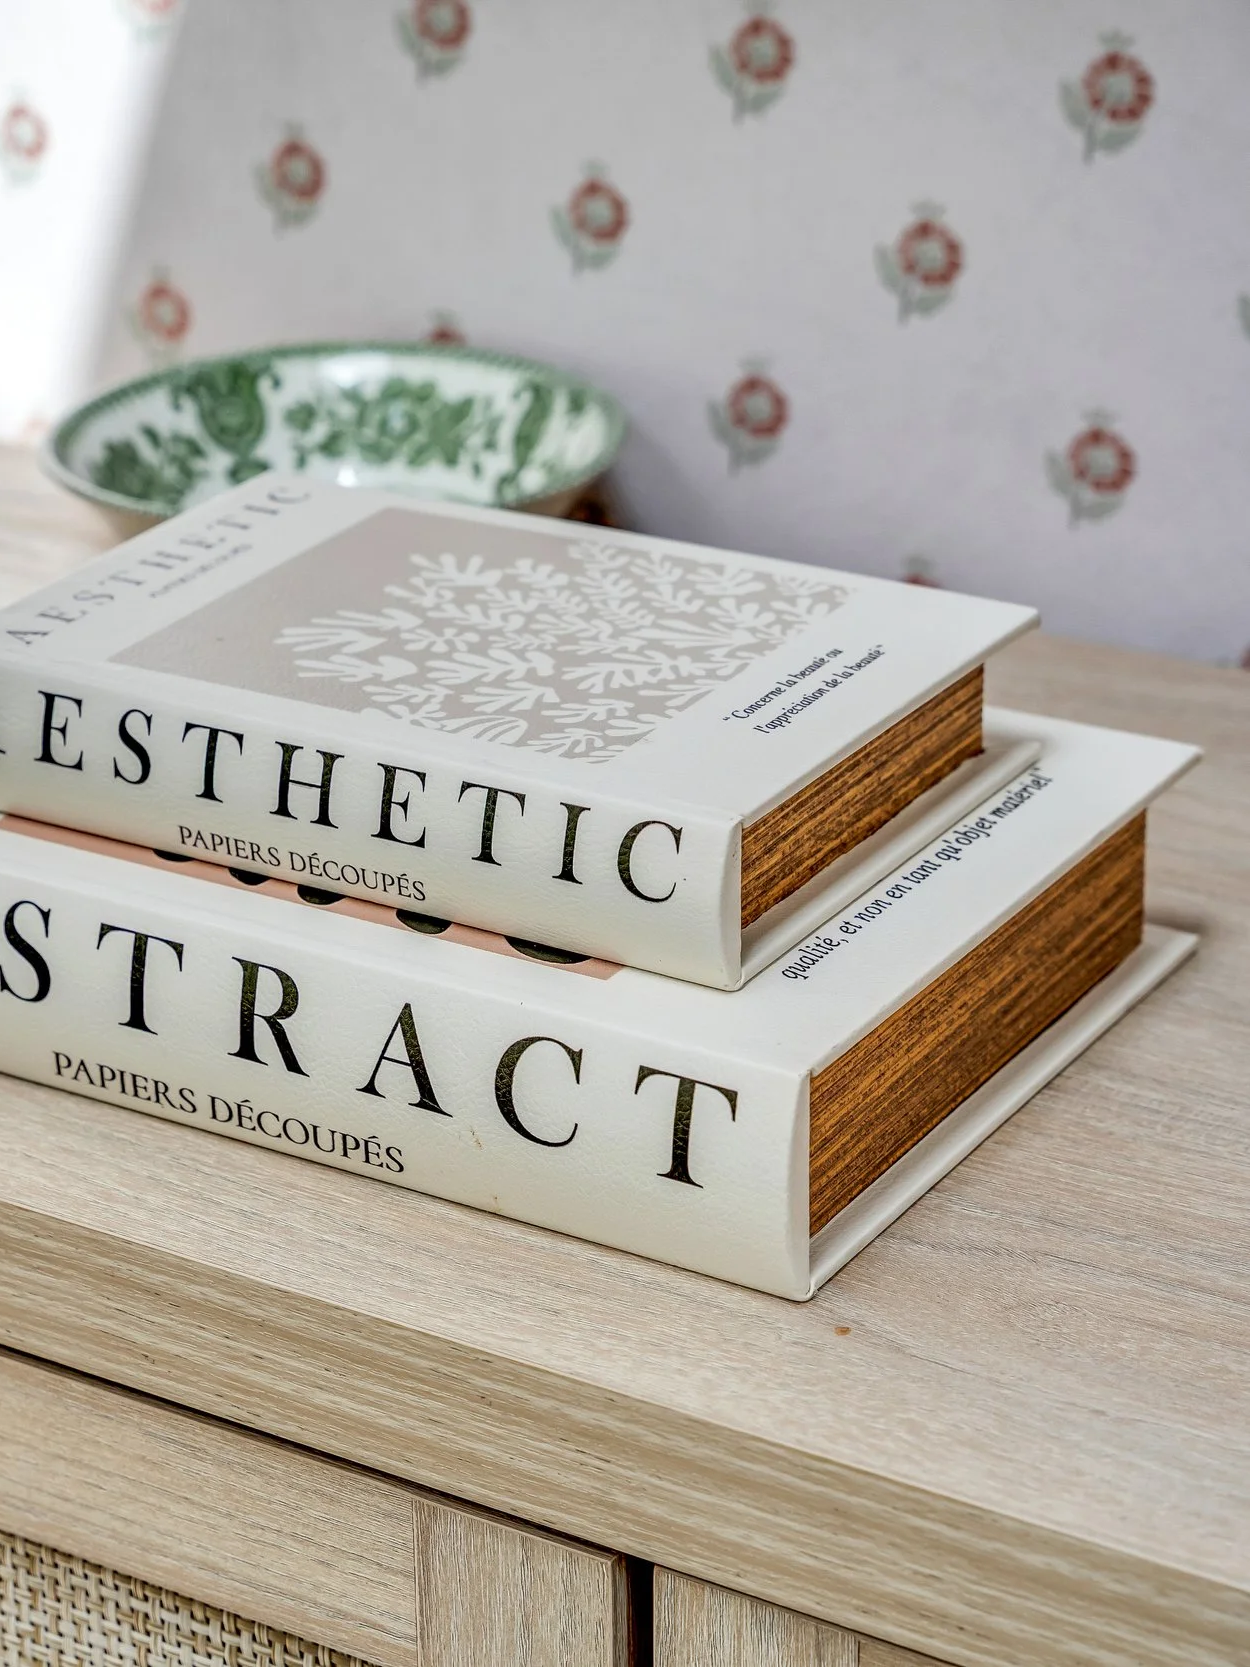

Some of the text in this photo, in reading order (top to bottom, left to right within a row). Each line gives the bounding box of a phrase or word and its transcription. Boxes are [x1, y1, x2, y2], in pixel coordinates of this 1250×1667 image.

[6, 485, 311, 645] AESTHETIC
[752, 687, 830, 734] l'appréciation
[821, 678, 843, 689] de
[832, 671, 854, 679] la
[777, 678, 799, 689] la
[788, 656, 830, 681] beauté
[826, 648, 843, 659] ou
[178, 825, 427, 901] PAPIERS DÉCOUPÉS
[781, 936, 849, 980] qualité,
[839, 920, 863, 935] et
[854, 899, 892, 922] non
[885, 883, 913, 899] en
[901, 859, 942, 884] tant
[935, 817, 997, 861] qu'objet
[53, 1051, 405, 1173] PAPIERS DÉCOUPÉS
